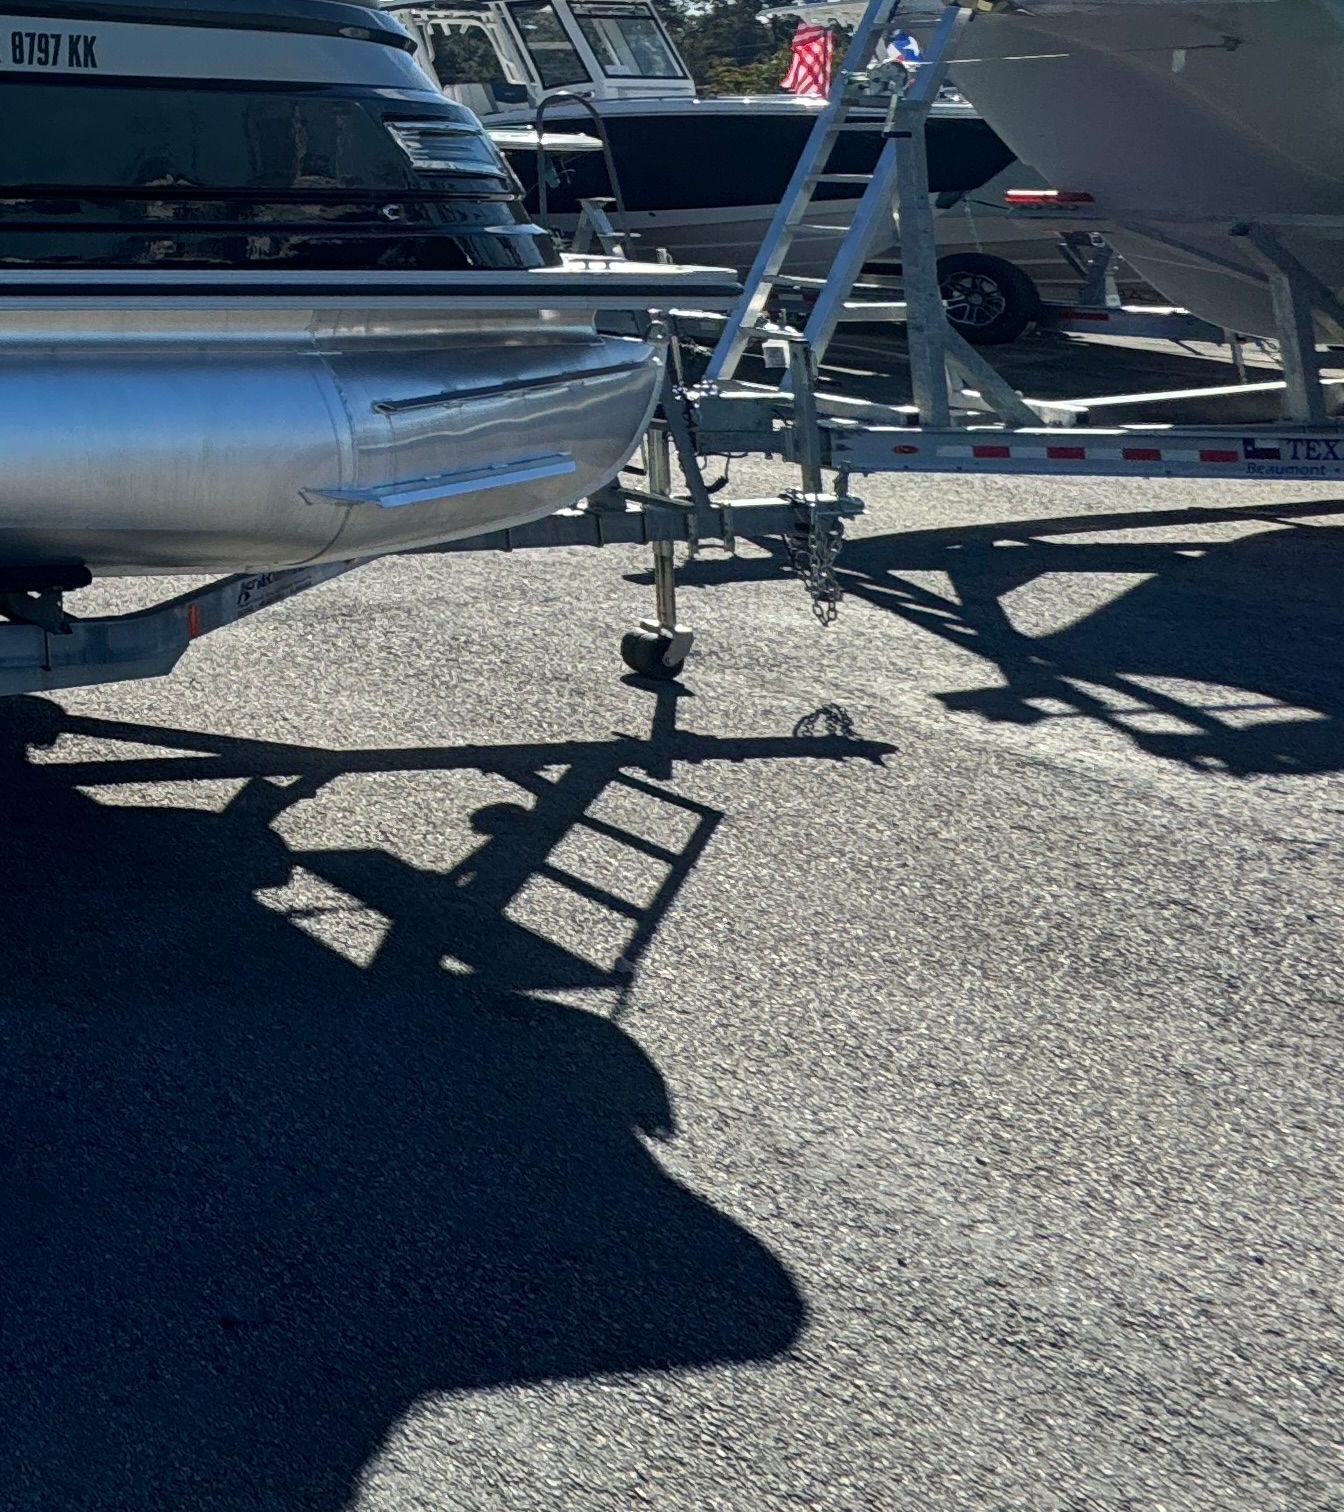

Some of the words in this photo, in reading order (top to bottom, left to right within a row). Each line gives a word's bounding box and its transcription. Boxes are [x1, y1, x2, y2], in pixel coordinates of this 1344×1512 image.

[11, 31, 62, 66] 8797
[68, 34, 99, 69] KK
[1246, 462, 1327, 475] Beaumont
